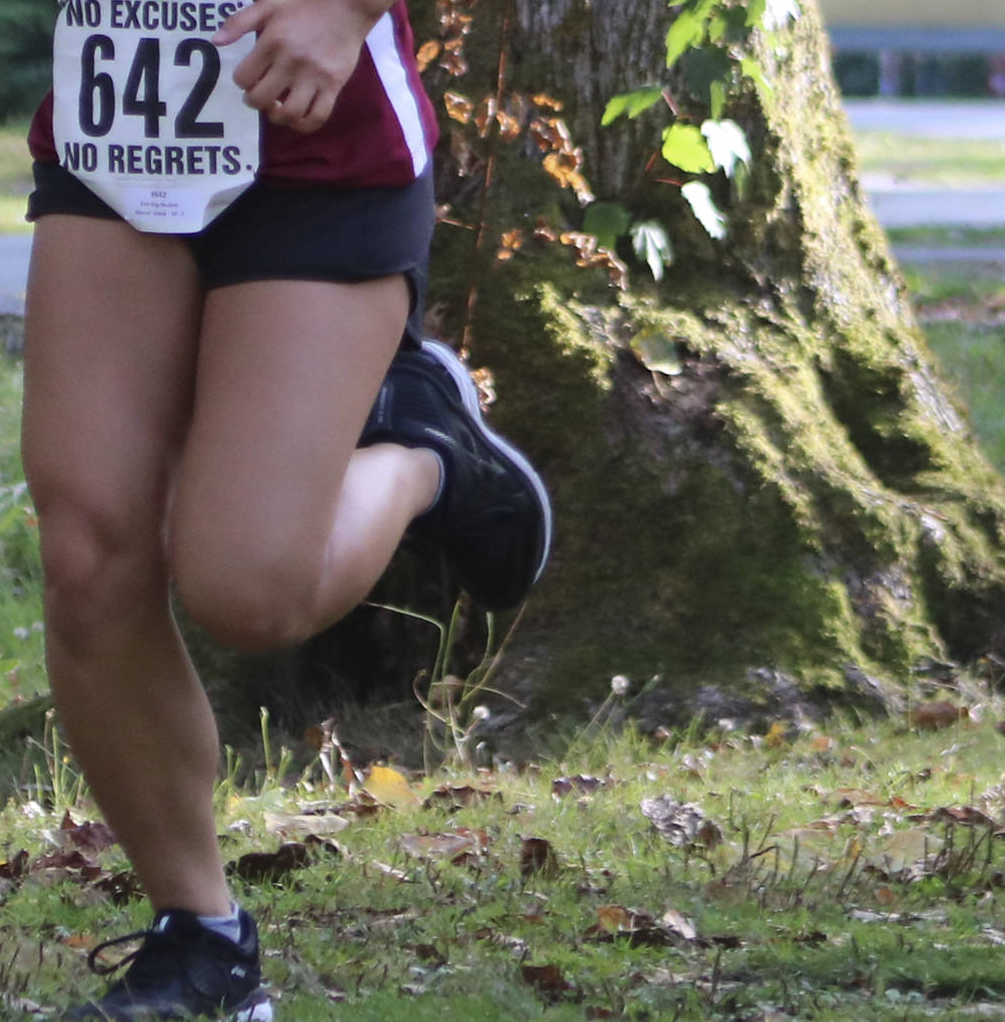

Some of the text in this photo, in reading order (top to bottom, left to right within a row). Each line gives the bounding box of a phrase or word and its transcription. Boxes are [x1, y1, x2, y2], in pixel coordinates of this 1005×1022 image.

[66, 0, 102, 28] NO
[79, 34, 225, 138] 642
[64, 143, 98, 172] NO
